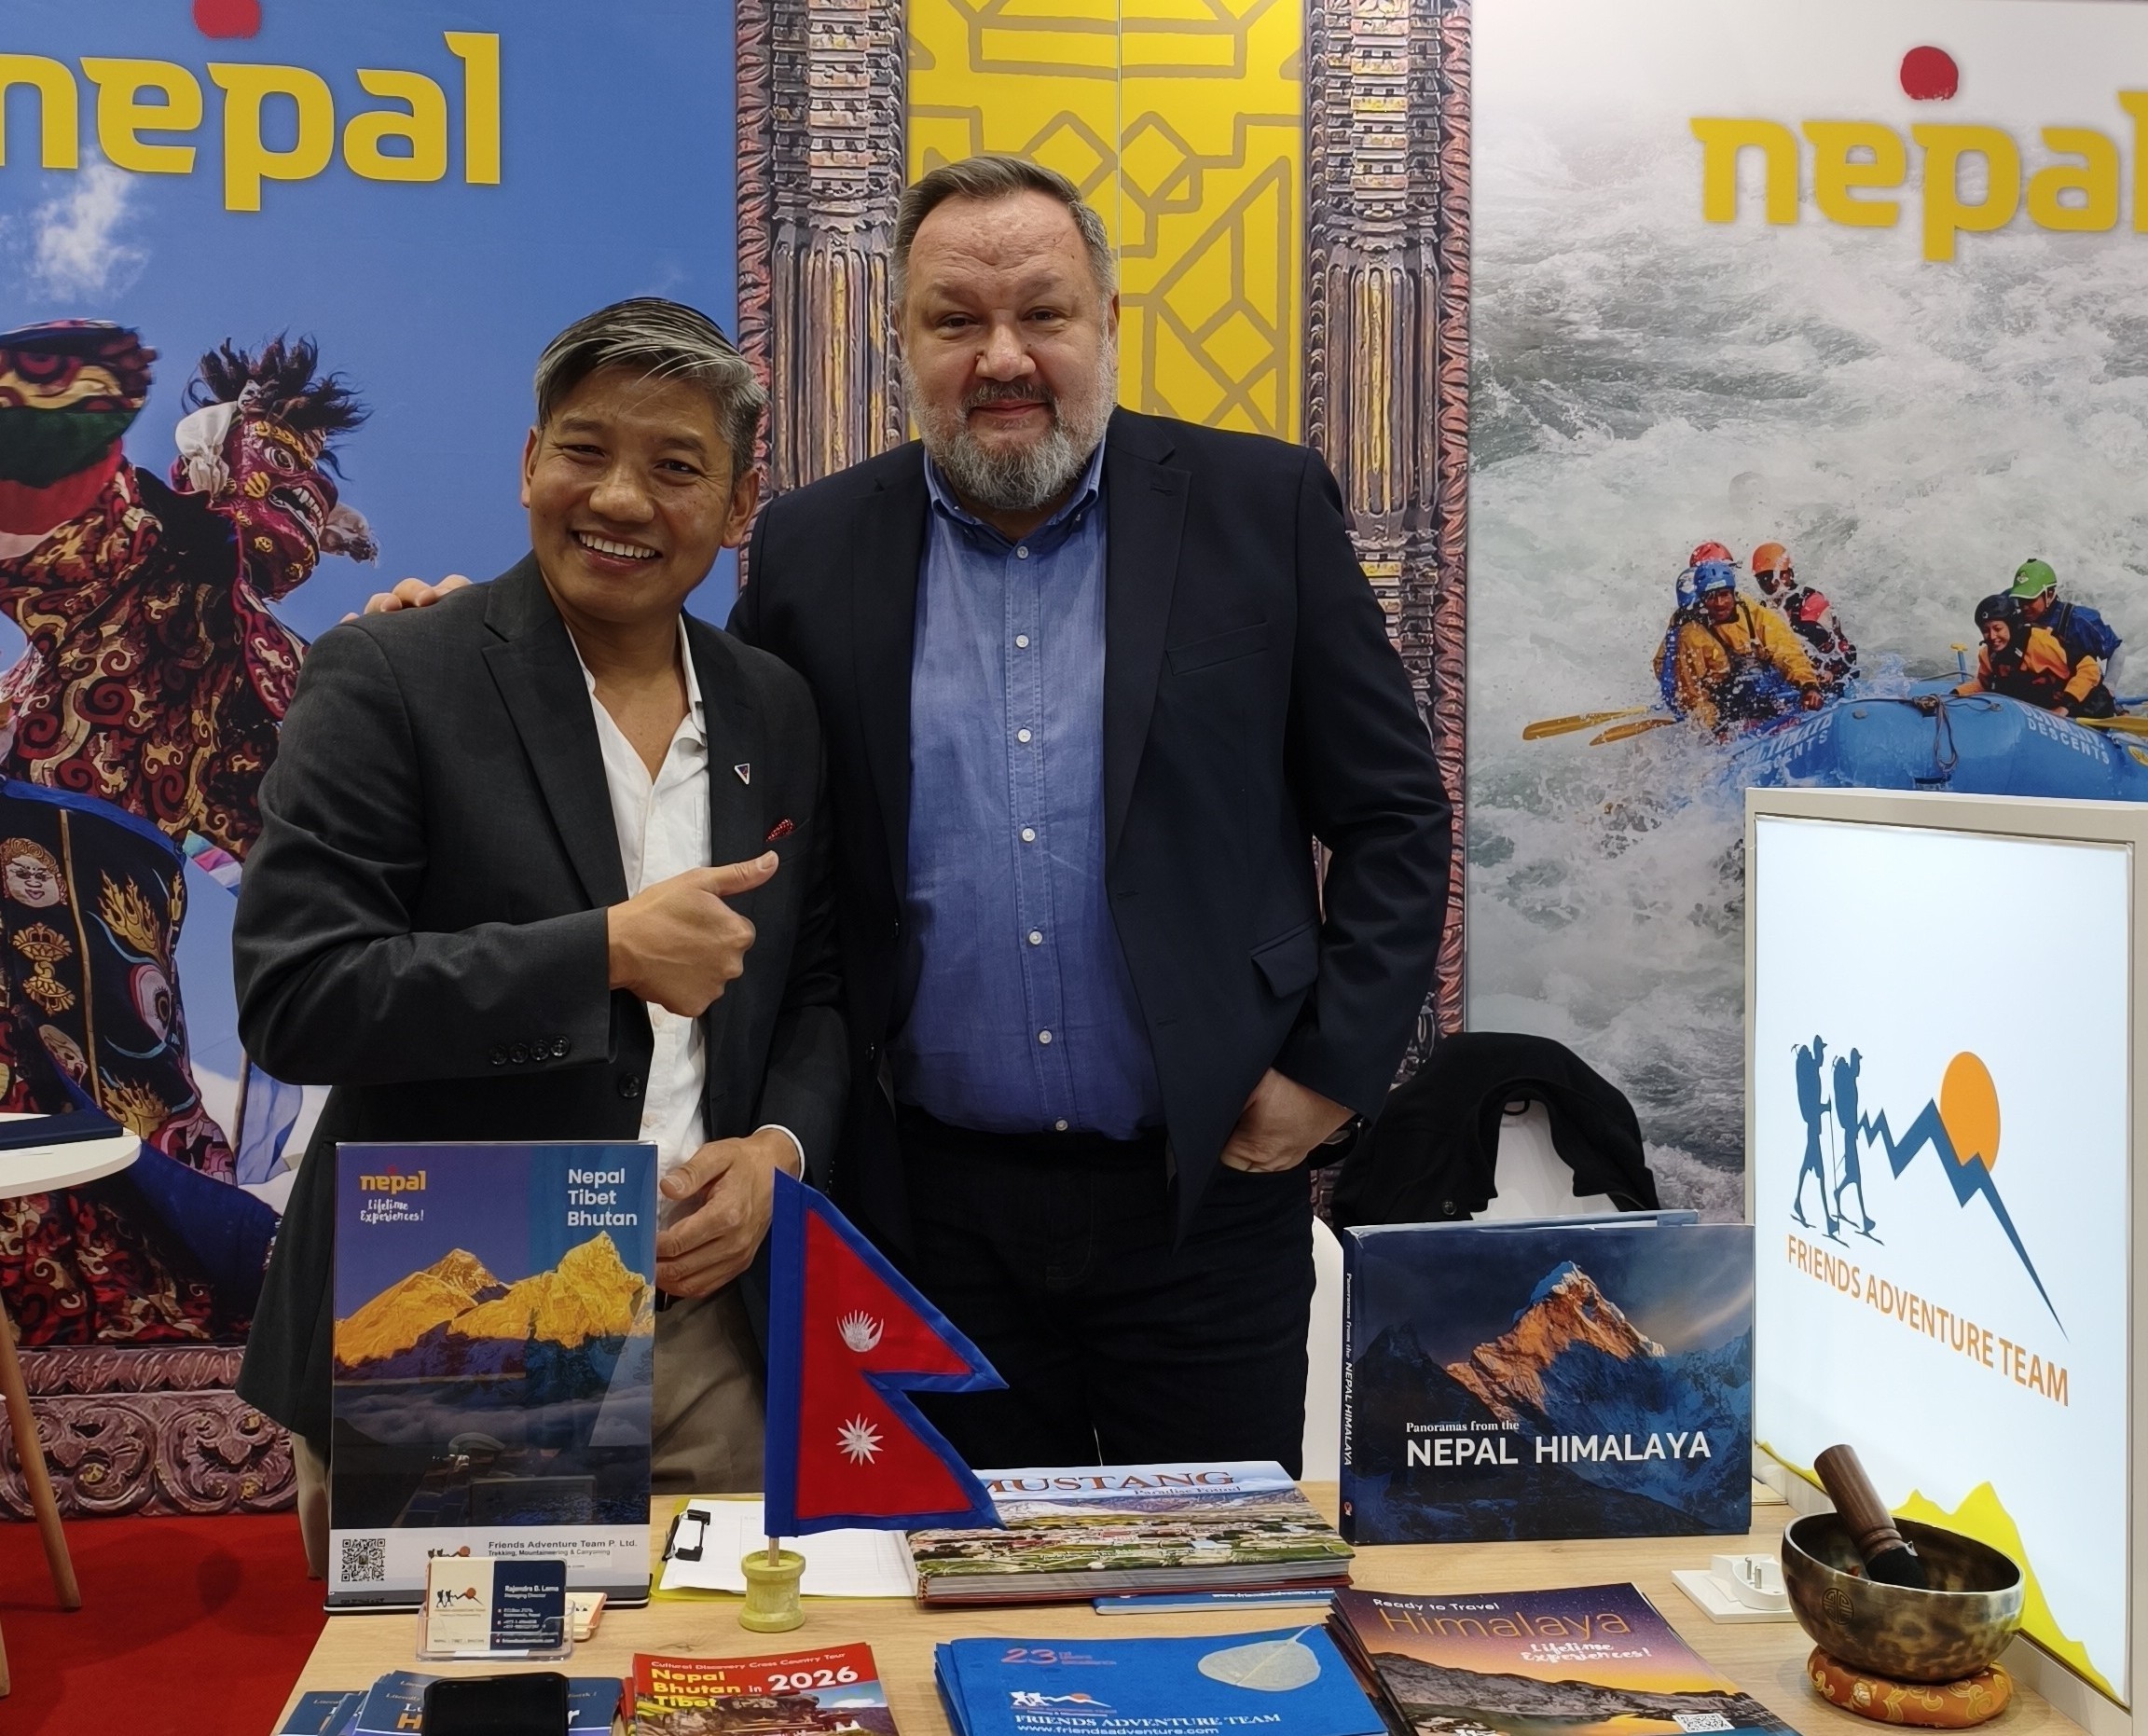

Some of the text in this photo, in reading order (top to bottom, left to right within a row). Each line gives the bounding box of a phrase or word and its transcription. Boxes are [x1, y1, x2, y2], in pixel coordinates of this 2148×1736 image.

[0, 31, 501, 212] nepal
[1689, 90, 2148, 263] nepal
[2027, 717, 2110, 765] DESCENTS
[360, 1170, 426, 1194] nepal
[568, 1167, 626, 1189] Nepal
[367, 1199, 408, 1213] Lifetime
[567, 1189, 617, 1206] Tibet
[360, 1209, 424, 1224] Experiences!
[567, 1210, 638, 1226] Bhutan
[1788, 1233, 2069, 1407] FRIENDS ADVENTURE TEAM
[1344, 1362, 1353, 1401] NEPAL
[1343, 1403, 1353, 1466] HIMALAYA
[1406, 1420, 1520, 1433] Panoramas from the
[1407, 1431, 1712, 1467] NEPAL HIMALAYA
[528, 1540, 577, 1549] Adventure
[1373, 1598, 1500, 1611] Ready to Travel
[1379, 1608, 1632, 1640] Himalaya
[1000, 1647, 1058, 1665] 23
[1521, 1647, 1652, 1663] Experiences!
[1531, 1643, 1615, 1655] Lifetime
[652, 1660, 693, 1670] Cultural
[779, 1656, 820, 1666] Country
[823, 1652, 847, 1660] Tour
[651, 1668, 725, 1682] Nepal
[653, 1681, 741, 1694] Bhutan
[767, 1666, 859, 1691] 2026
[654, 1695, 718, 1707] Tibet
[1014, 1714, 1281, 1727] FRIENDS ADVENTURE TEAM
